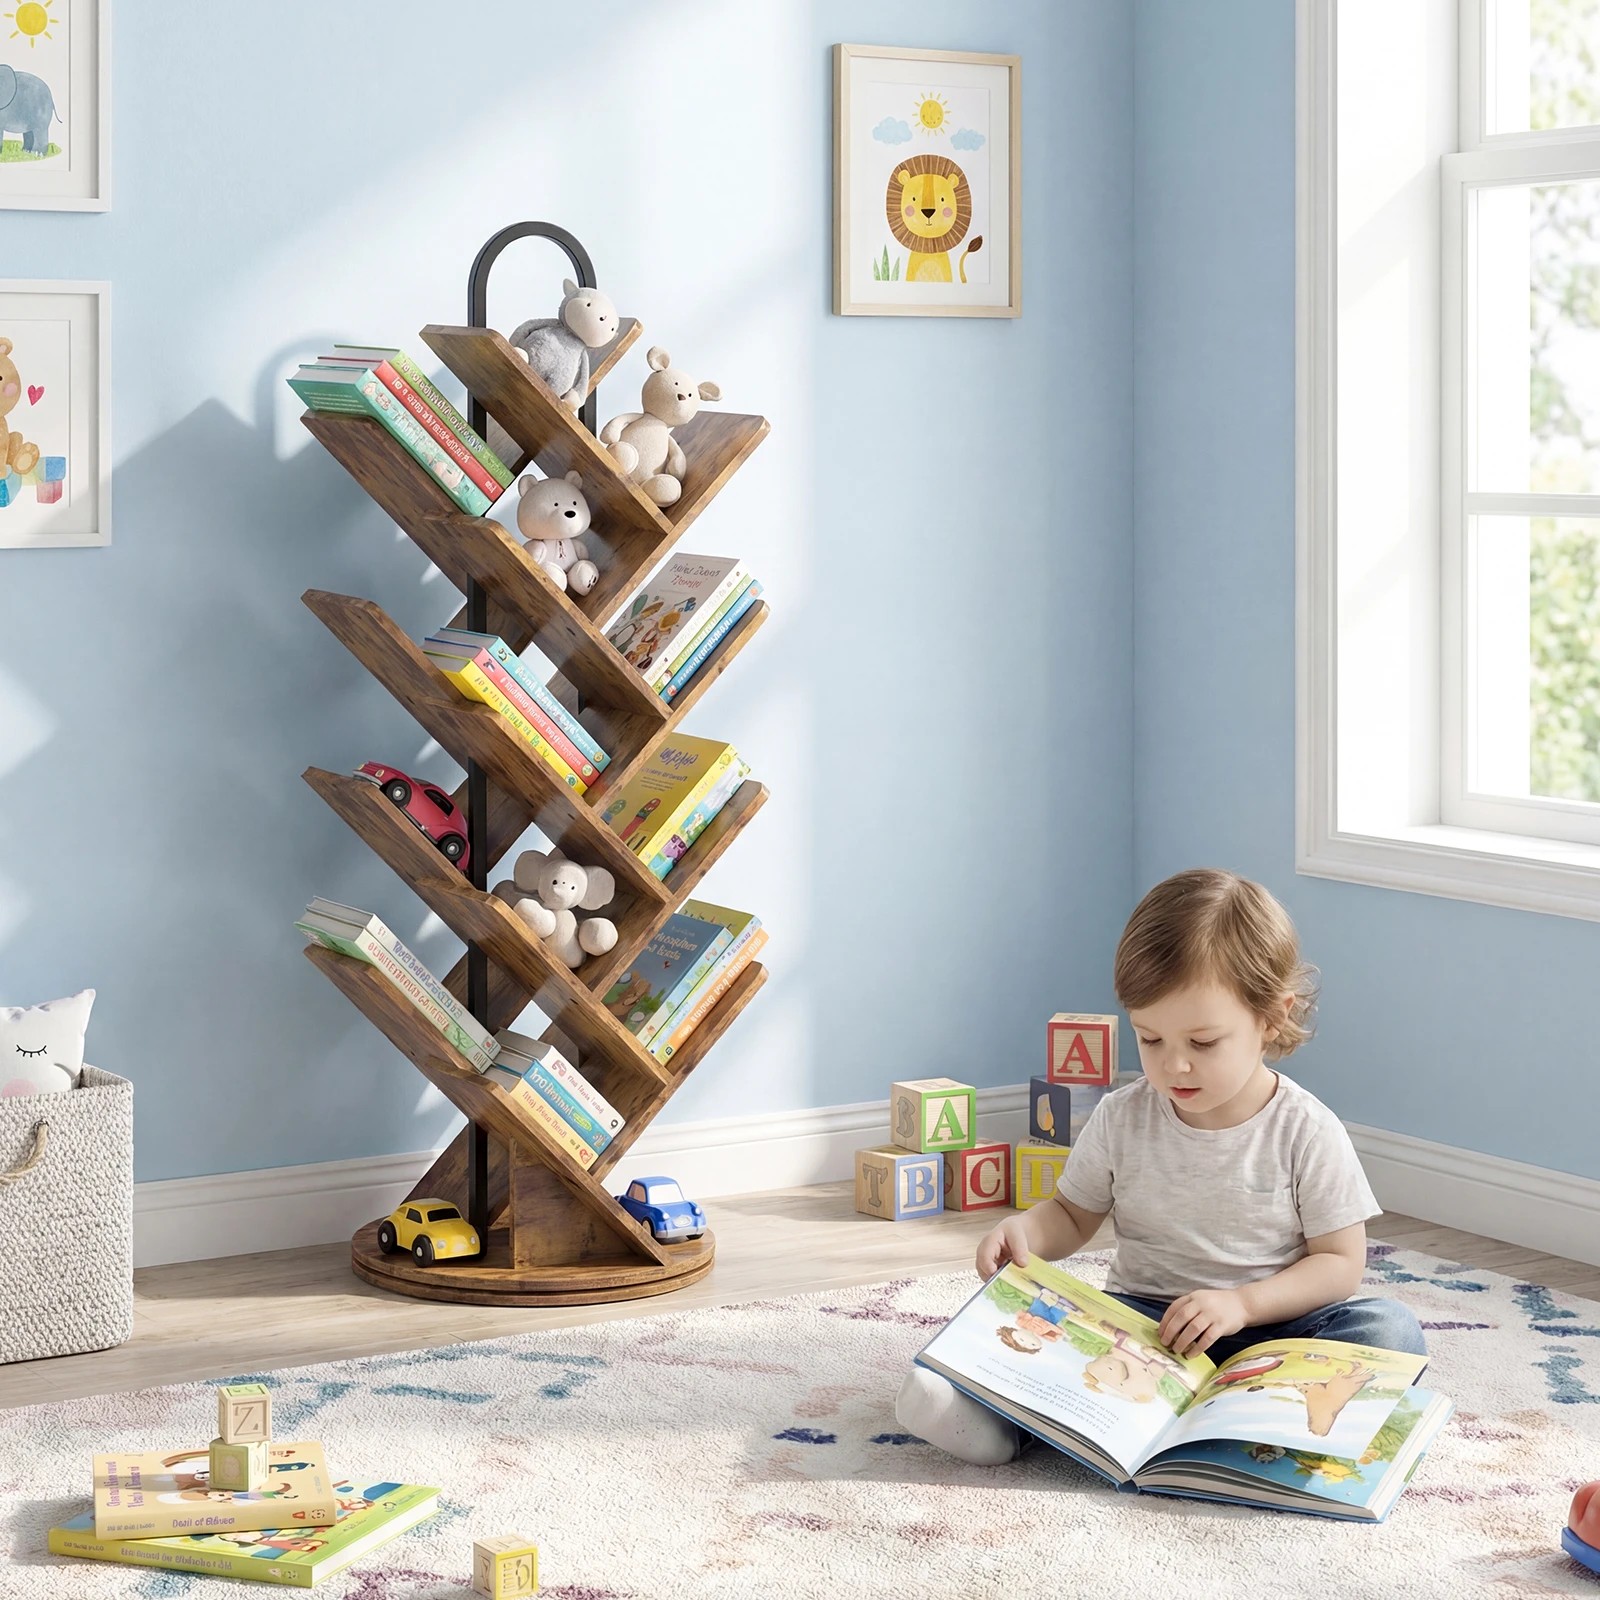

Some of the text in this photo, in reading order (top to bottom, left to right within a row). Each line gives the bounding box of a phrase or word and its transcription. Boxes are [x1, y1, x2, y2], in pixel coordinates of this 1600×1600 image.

[1057, 1033, 1100, 1074] A
[927, 1099, 966, 1143] A
[862, 1163, 888, 1207] T
[903, 1166, 935, 1208] B
[970, 1157, 1001, 1198] C
[1027, 1159, 1064, 1199] D
[233, 1405, 261, 1437] Z
